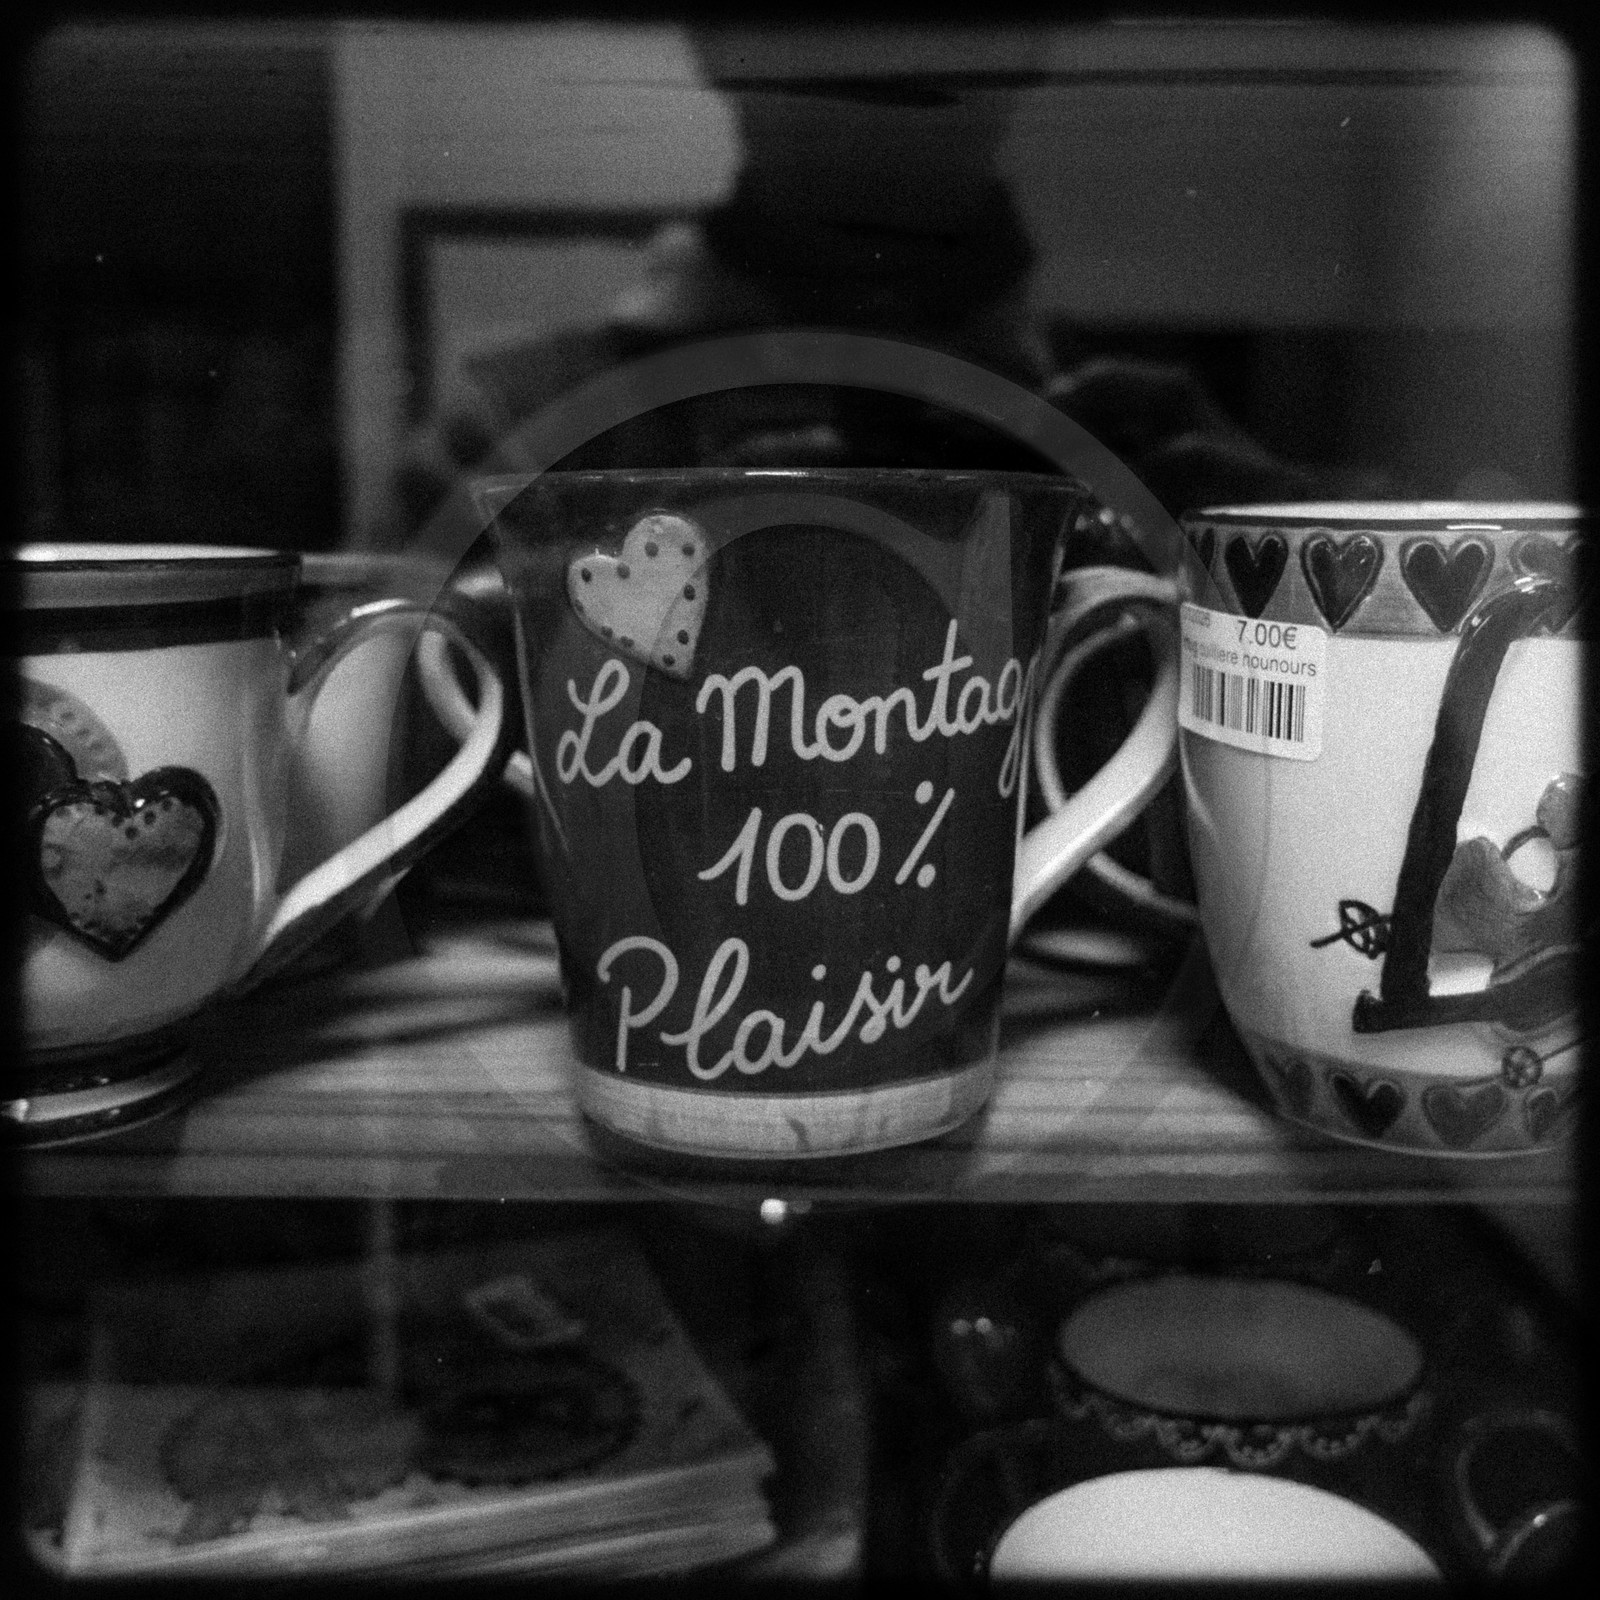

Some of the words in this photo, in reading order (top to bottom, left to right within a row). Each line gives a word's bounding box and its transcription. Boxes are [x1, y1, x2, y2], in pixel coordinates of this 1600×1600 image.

[1238, 620, 1297, 650] 7.00€
[1242, 654, 1317, 677] nounours
[557, 658, 692, 787] La
[598, 935, 973, 1080] Plaisir
